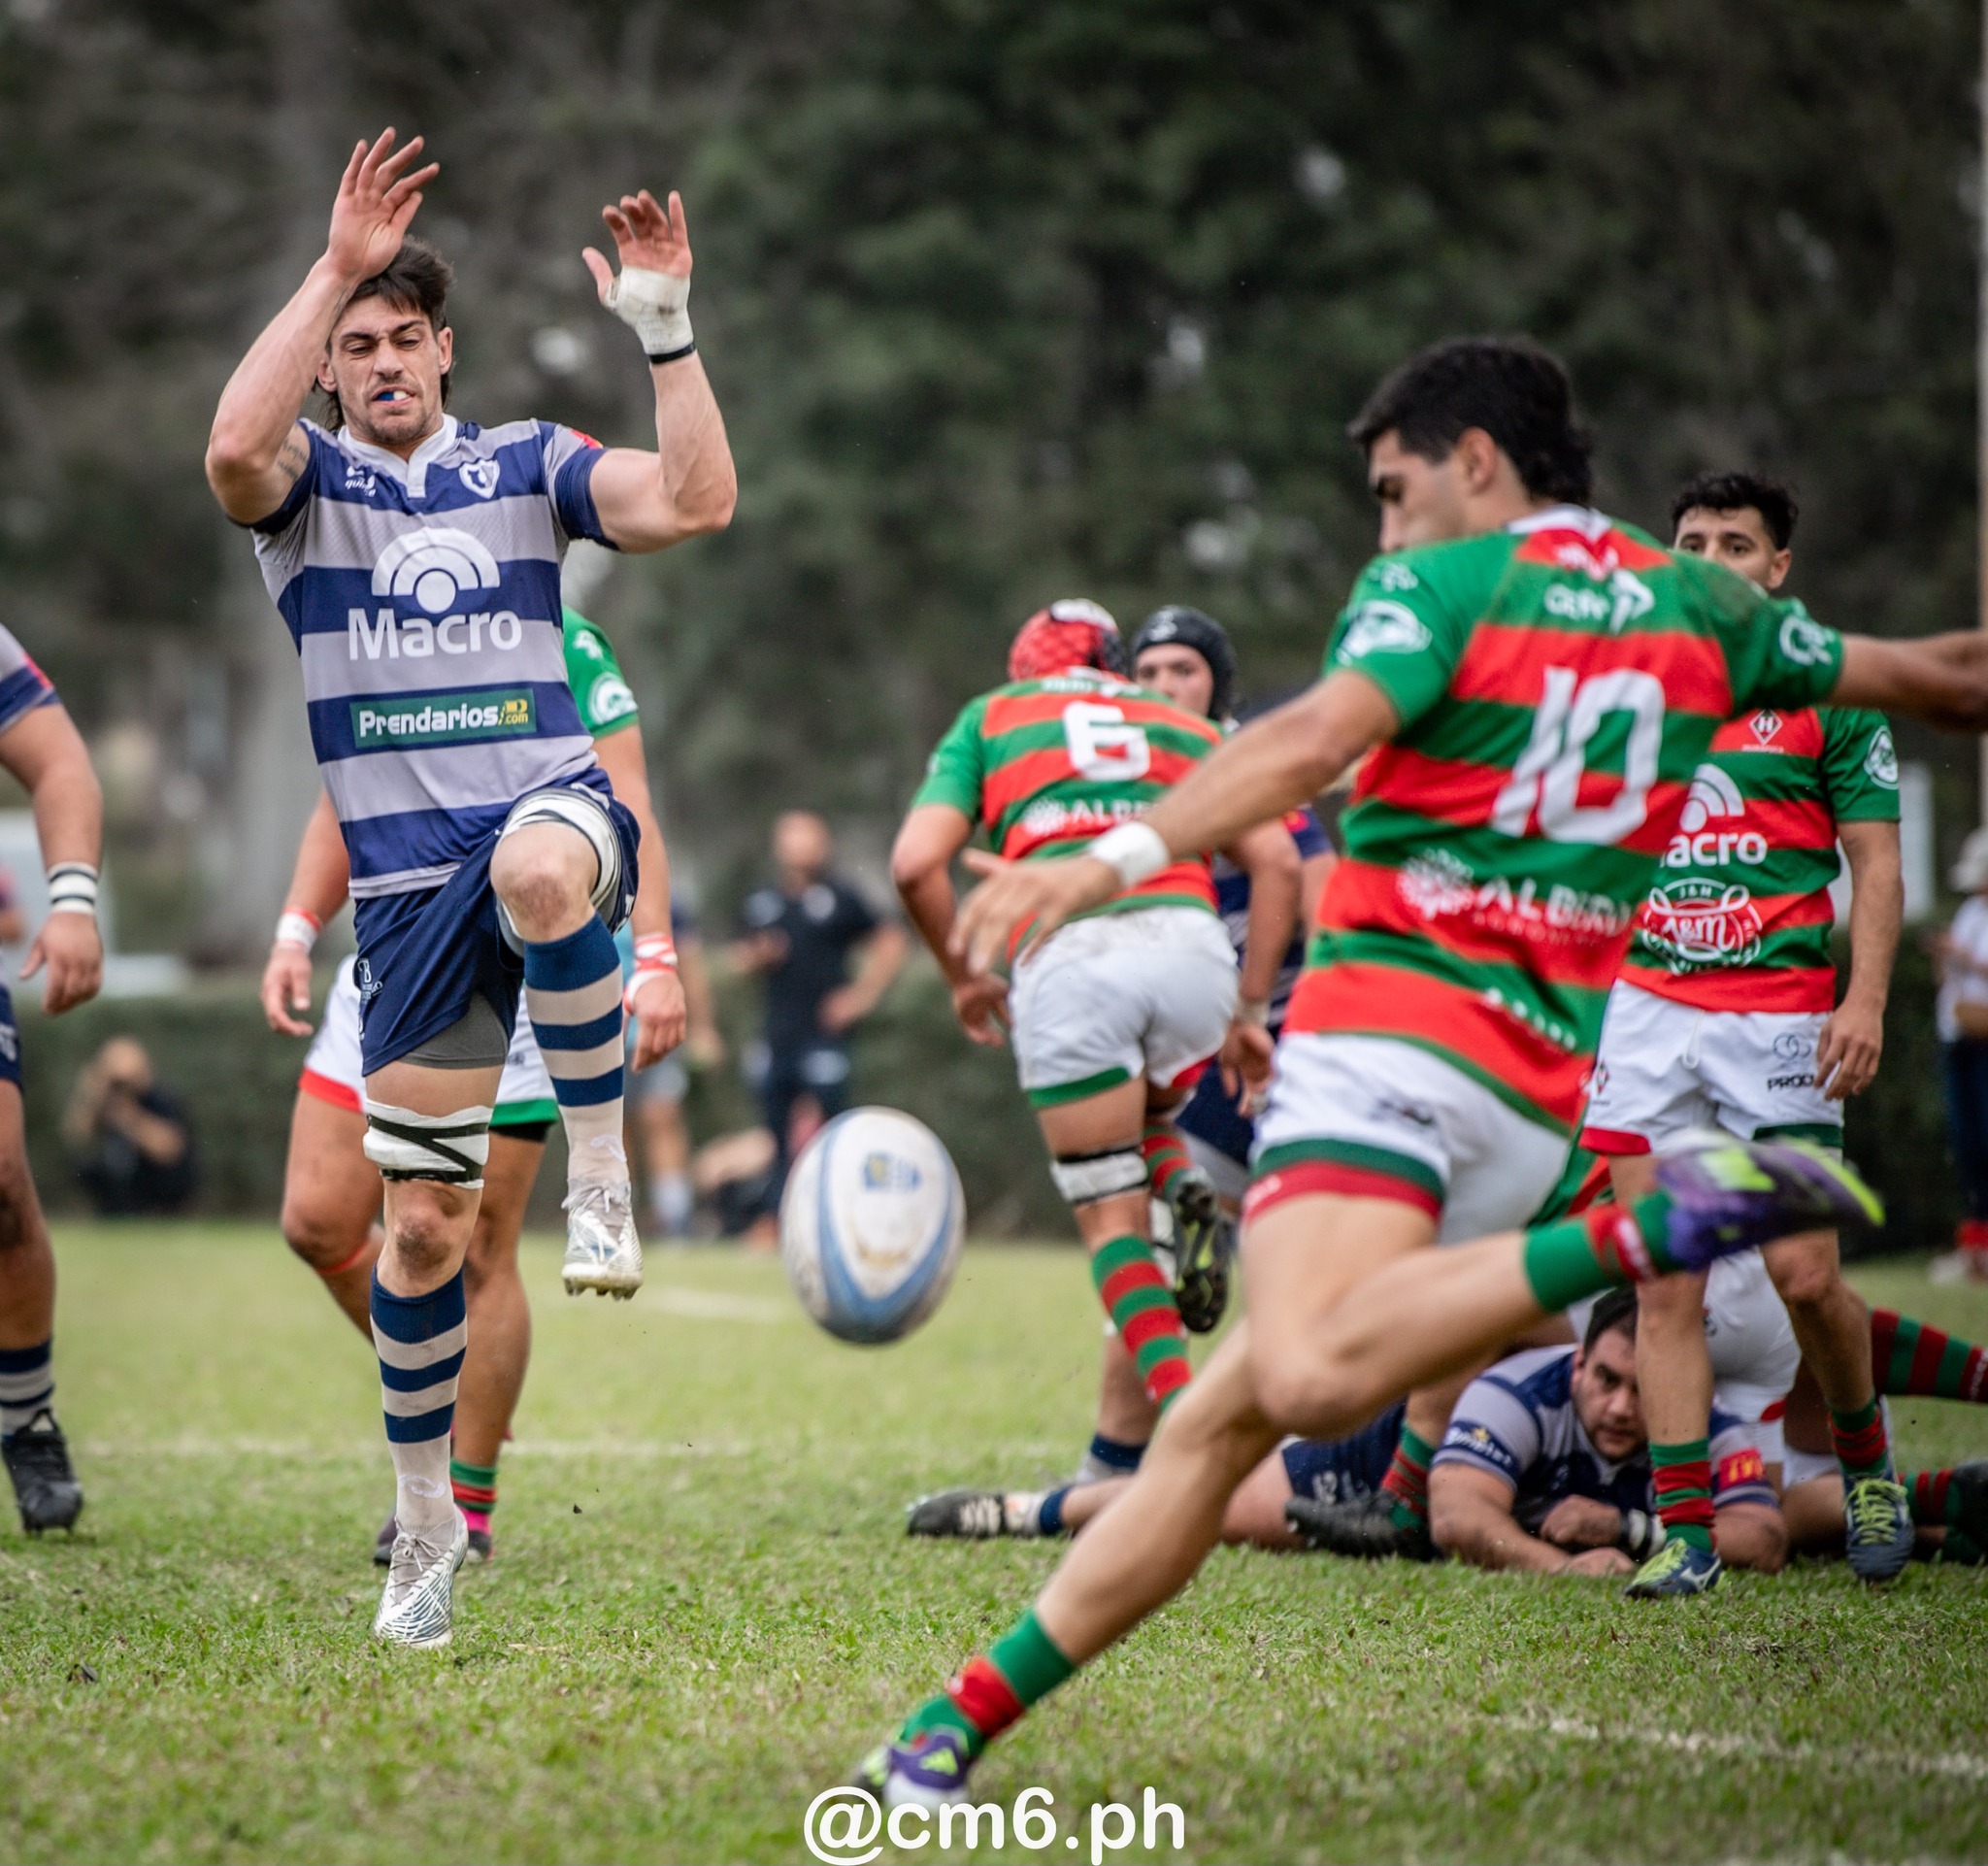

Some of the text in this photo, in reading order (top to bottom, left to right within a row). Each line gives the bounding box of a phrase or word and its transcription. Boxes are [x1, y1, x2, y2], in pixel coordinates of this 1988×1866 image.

[348, 609, 522, 660] Macro
[359, 703, 499, 738] Prendarios
[1064, 702, 1150, 781] 6
[1495, 668, 1665, 842] 10
[1659, 832, 1769, 868] acro
